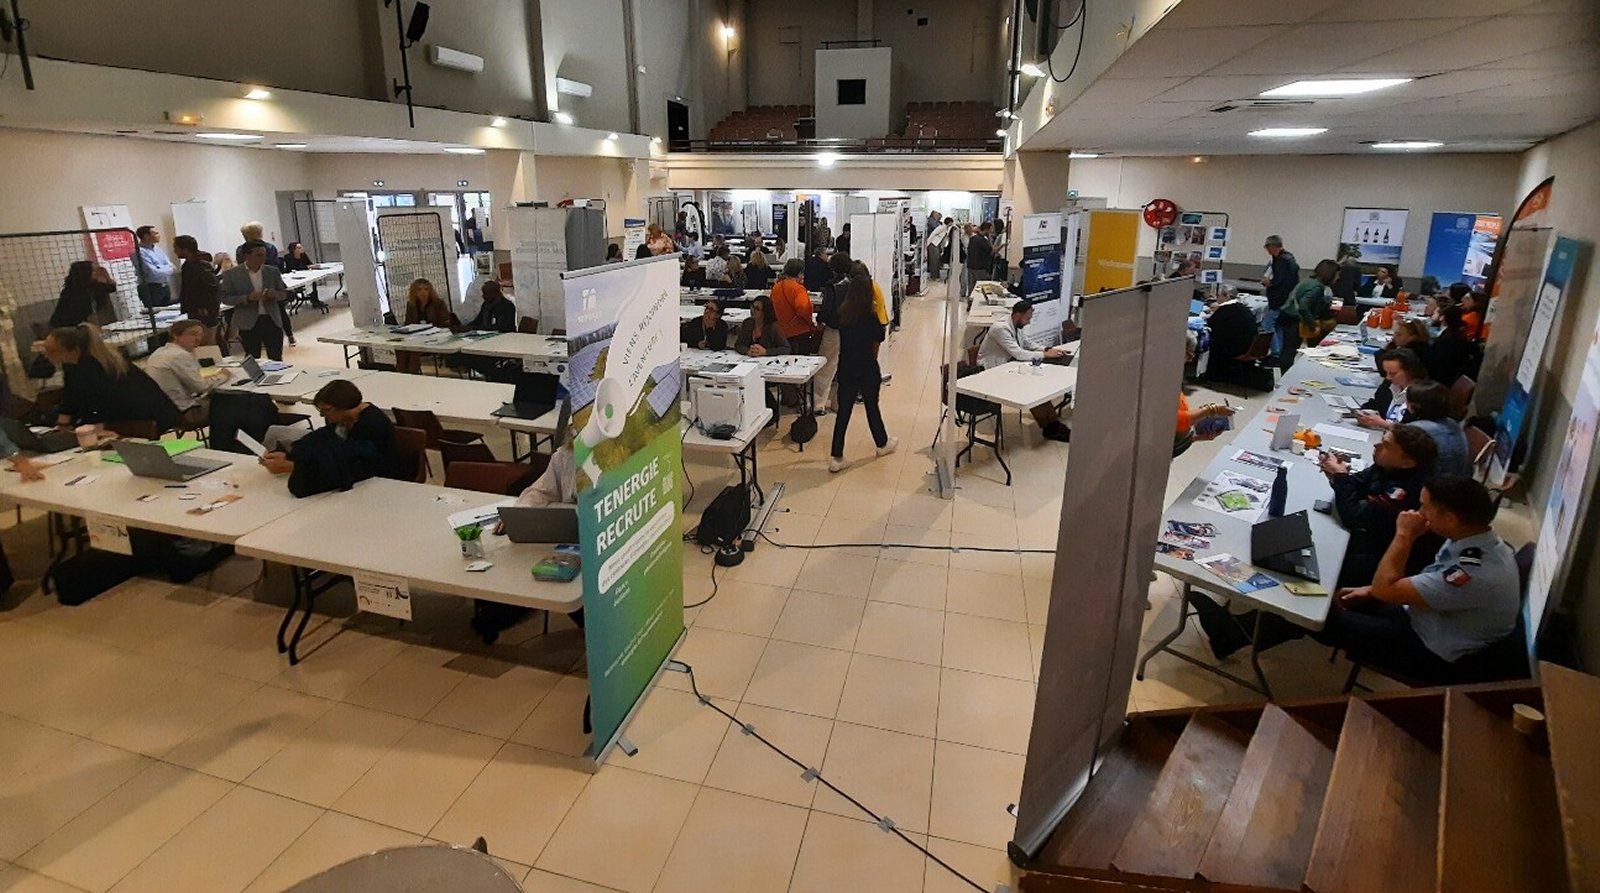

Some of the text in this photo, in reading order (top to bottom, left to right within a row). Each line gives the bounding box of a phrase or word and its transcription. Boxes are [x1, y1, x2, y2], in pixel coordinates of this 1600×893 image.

[622, 331, 640, 365] VIENS
[594, 456, 660, 523] TENERGIE
[596, 488, 657, 556] RECRUTE
